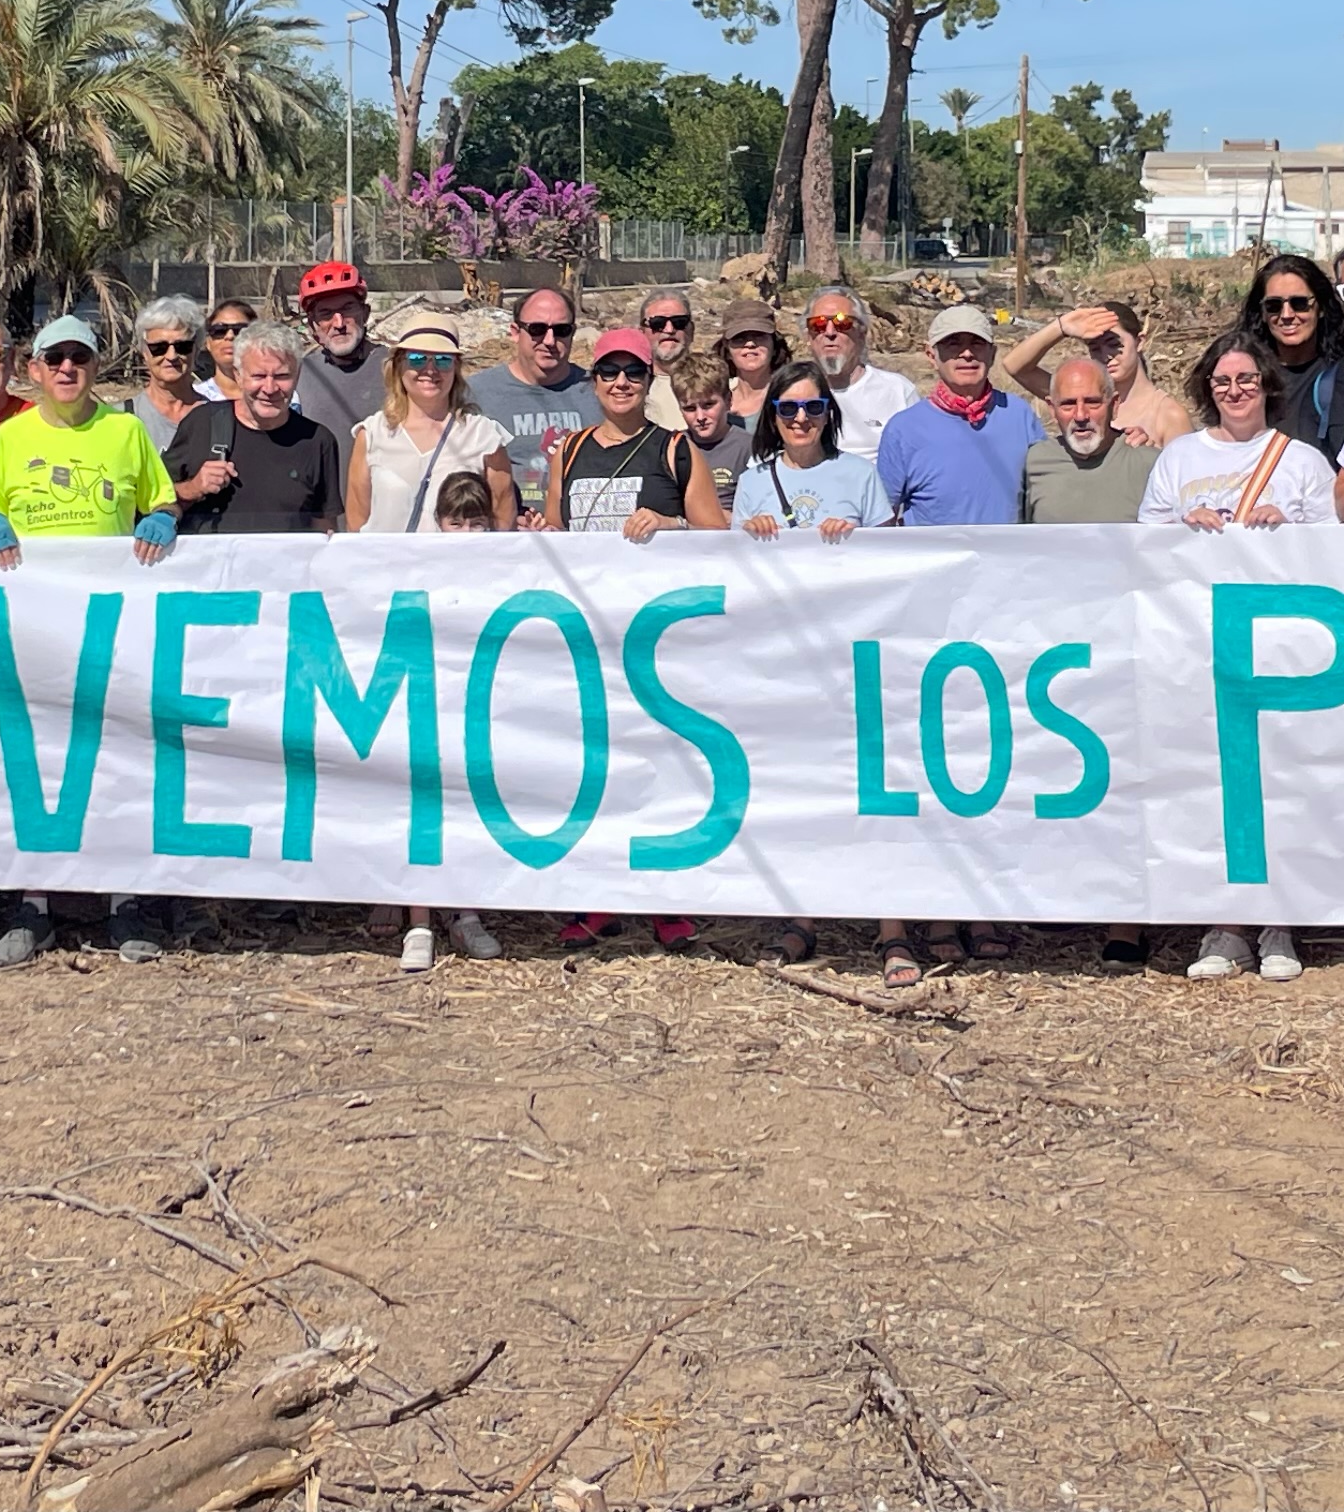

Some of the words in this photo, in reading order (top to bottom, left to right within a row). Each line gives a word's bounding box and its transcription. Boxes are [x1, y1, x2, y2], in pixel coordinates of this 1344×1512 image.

[513, 411, 583, 436] MARIO
[26, 501, 56, 515] Acho
[27, 510, 94, 525] Encuentros
[853, 640, 1110, 819] LOS
